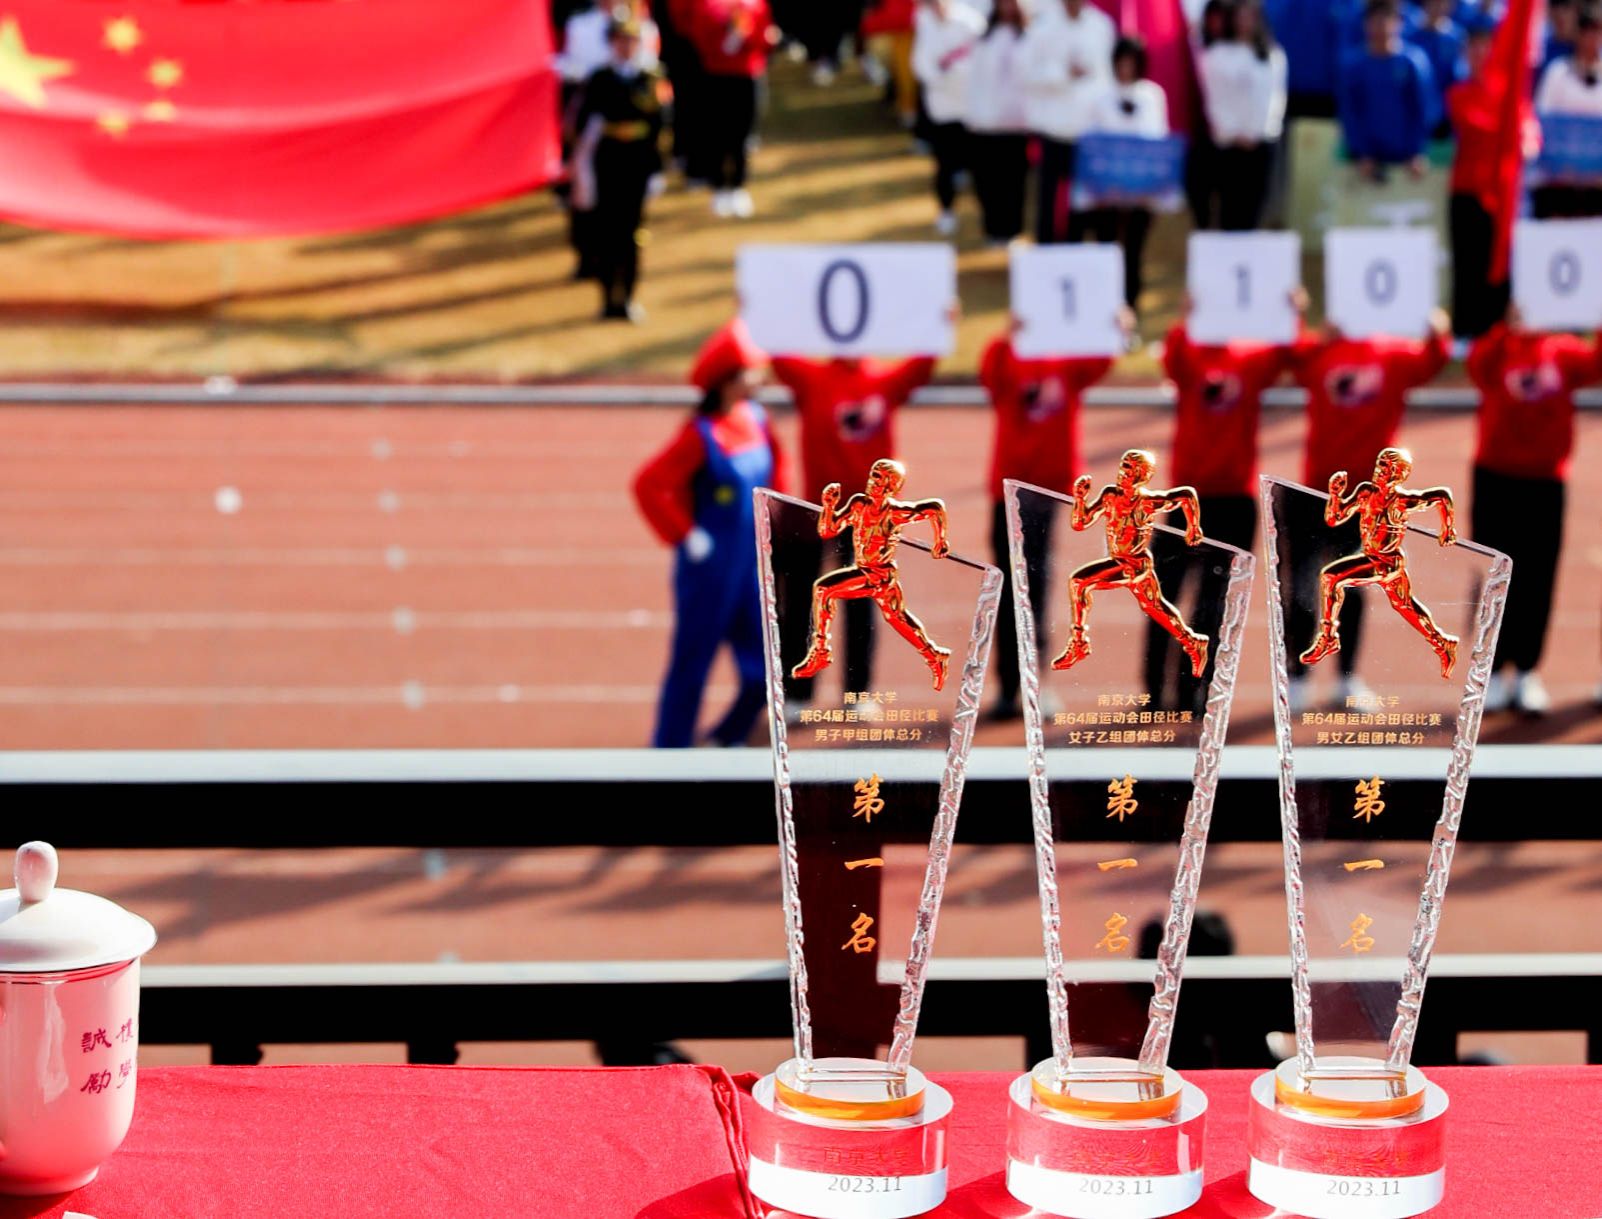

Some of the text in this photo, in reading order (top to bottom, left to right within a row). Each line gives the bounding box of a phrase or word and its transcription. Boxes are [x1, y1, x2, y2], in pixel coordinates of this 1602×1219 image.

[1549, 250, 1581, 295] 0
[1231, 264, 1252, 309] 1
[1363, 259, 1399, 305] 0
[817, 259, 871, 343] 0
[1057, 277, 1077, 323] 1
[843, 691, 898, 705] 南京大学
[1097, 693, 1152, 707] 南京大学
[1053, 710, 1194, 726] 第64届运动会田径比赛
[1301, 712, 1442, 727] 第64届运动会田径比赛
[815, 728, 922, 742] 男子甲组团体总分
[1068, 730, 1176, 744] 女子乙组团体总分
[1316, 731, 1425, 745] 男女乙组团体总分
[841, 773, 885, 953] 第一名
[1095, 774, 1138, 953] 第一名
[1339, 775, 1385, 953] 第一名
[828, 1176, 903, 1193] 2023.11
[1079, 1178, 1153, 1195] 2023.11
[1326, 1180, 1401, 1197] 2023.11
